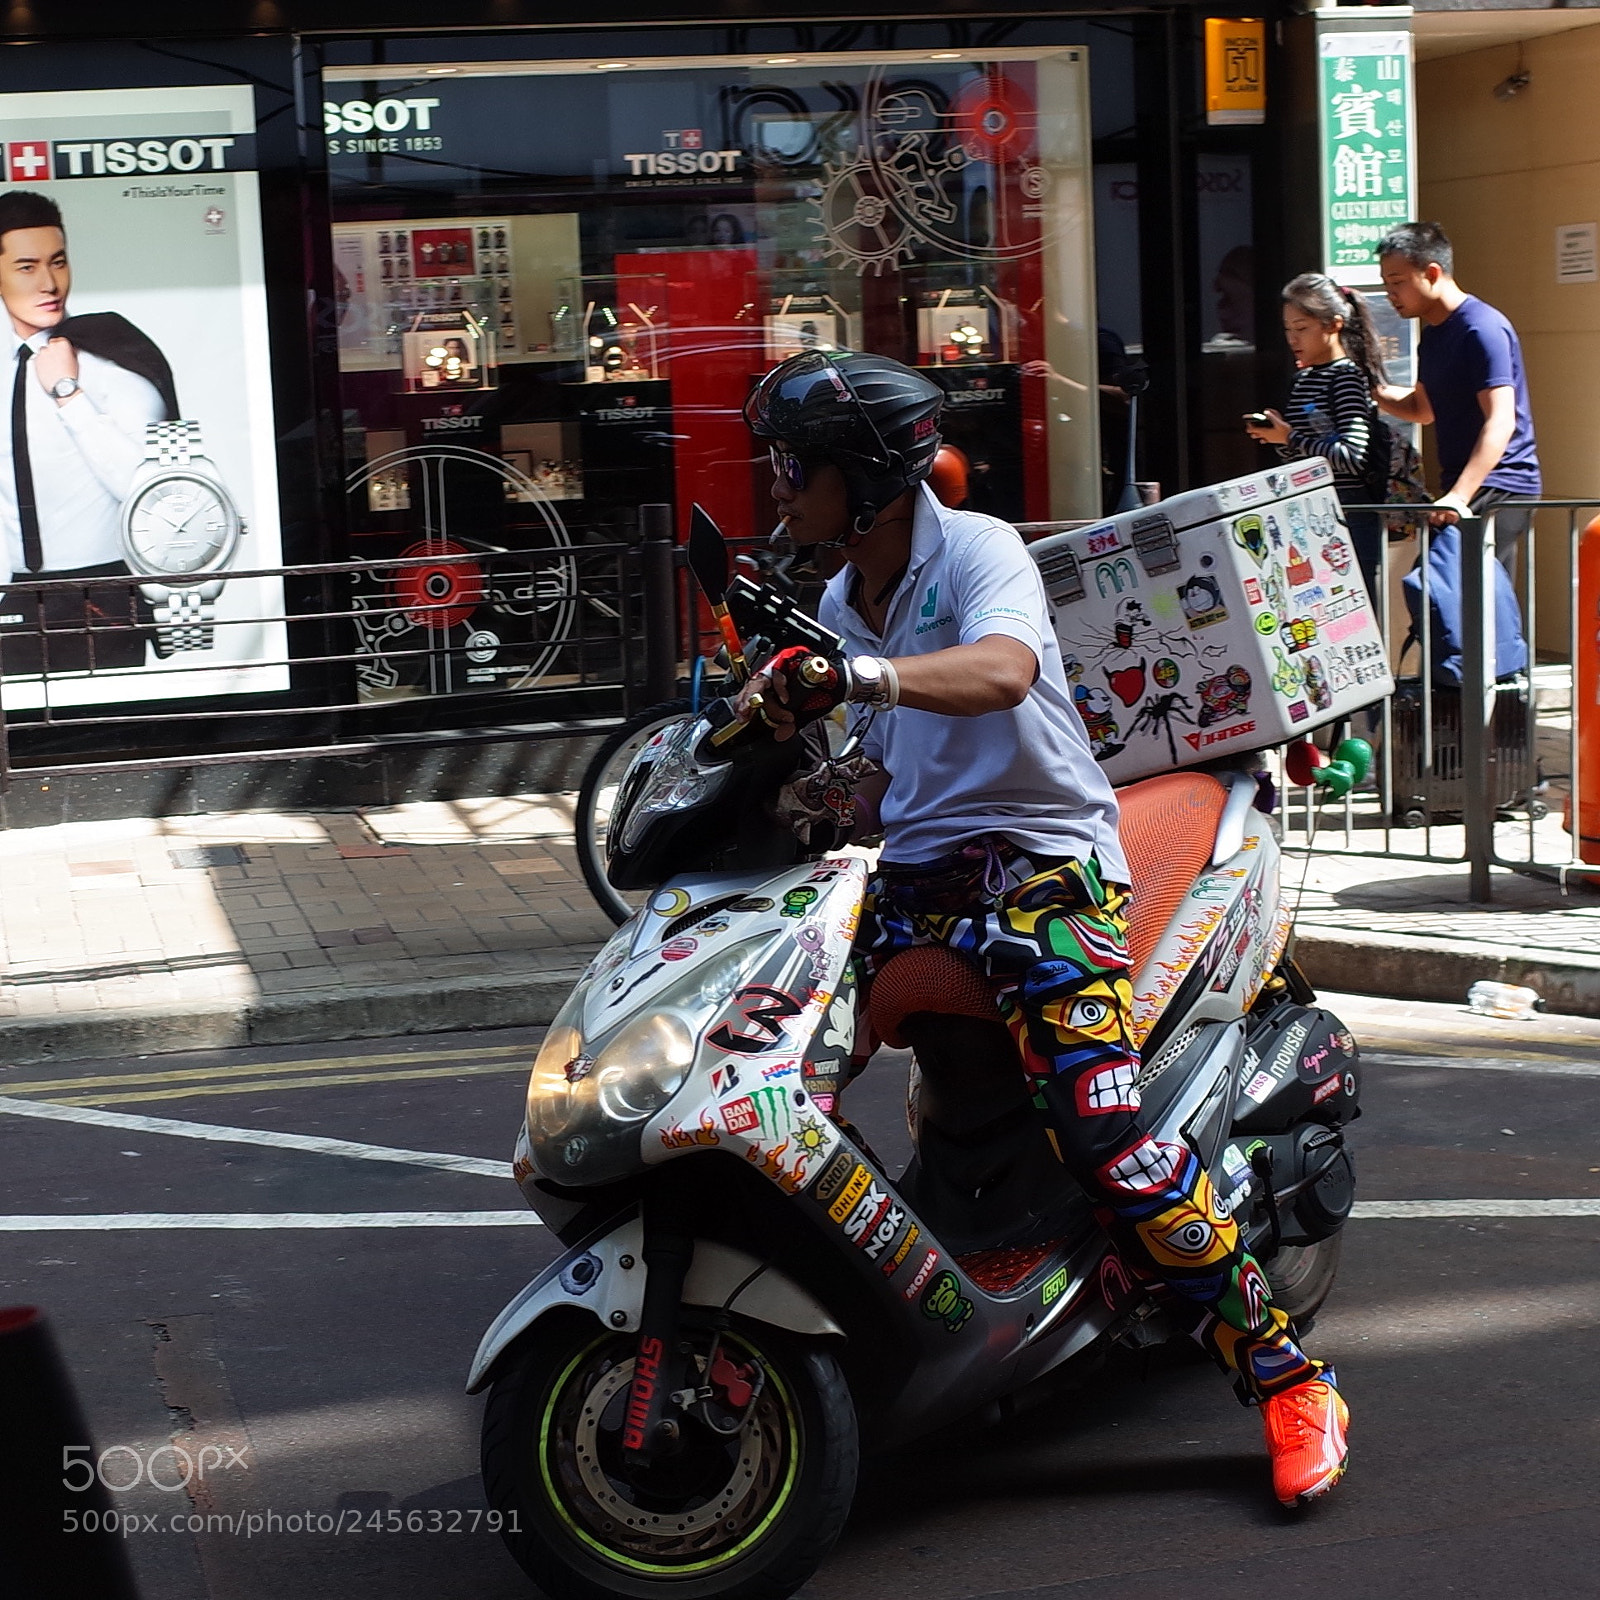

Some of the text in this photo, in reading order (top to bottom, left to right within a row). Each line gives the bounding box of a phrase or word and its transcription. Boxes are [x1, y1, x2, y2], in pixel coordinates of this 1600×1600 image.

[56, 138, 234, 175] TISSOT
[345, 138, 400, 153] SINCE
[404, 137, 443, 151] 1853
[623, 150, 742, 175] TISSOT
[122, 185, 226, 199] #ThisIsYourTime
[421, 416, 483, 430] TISSOT
[596, 407, 656, 420] TISSOT
[974, 607, 1030, 619] deliveroo
[915, 616, 952, 635] deliveroo
[1270, 1020, 1308, 1079] movistar
[804, 1076, 837, 1092] rembo
[1247, 1074, 1269, 1096] KISS
[724, 1101, 753, 1117] BAN
[728, 1115, 752, 1131] DAI
[820, 1156, 849, 1196] SHOEI
[833, 1167, 868, 1217] ÖHLINS
[843, 1180, 888, 1243] SBK
[864, 1206, 904, 1260] NGK
[905, 1252, 937, 1299] MOTUL
[1046, 1273, 1065, 1298] agv
[622, 1334, 664, 1450] SHOWA
